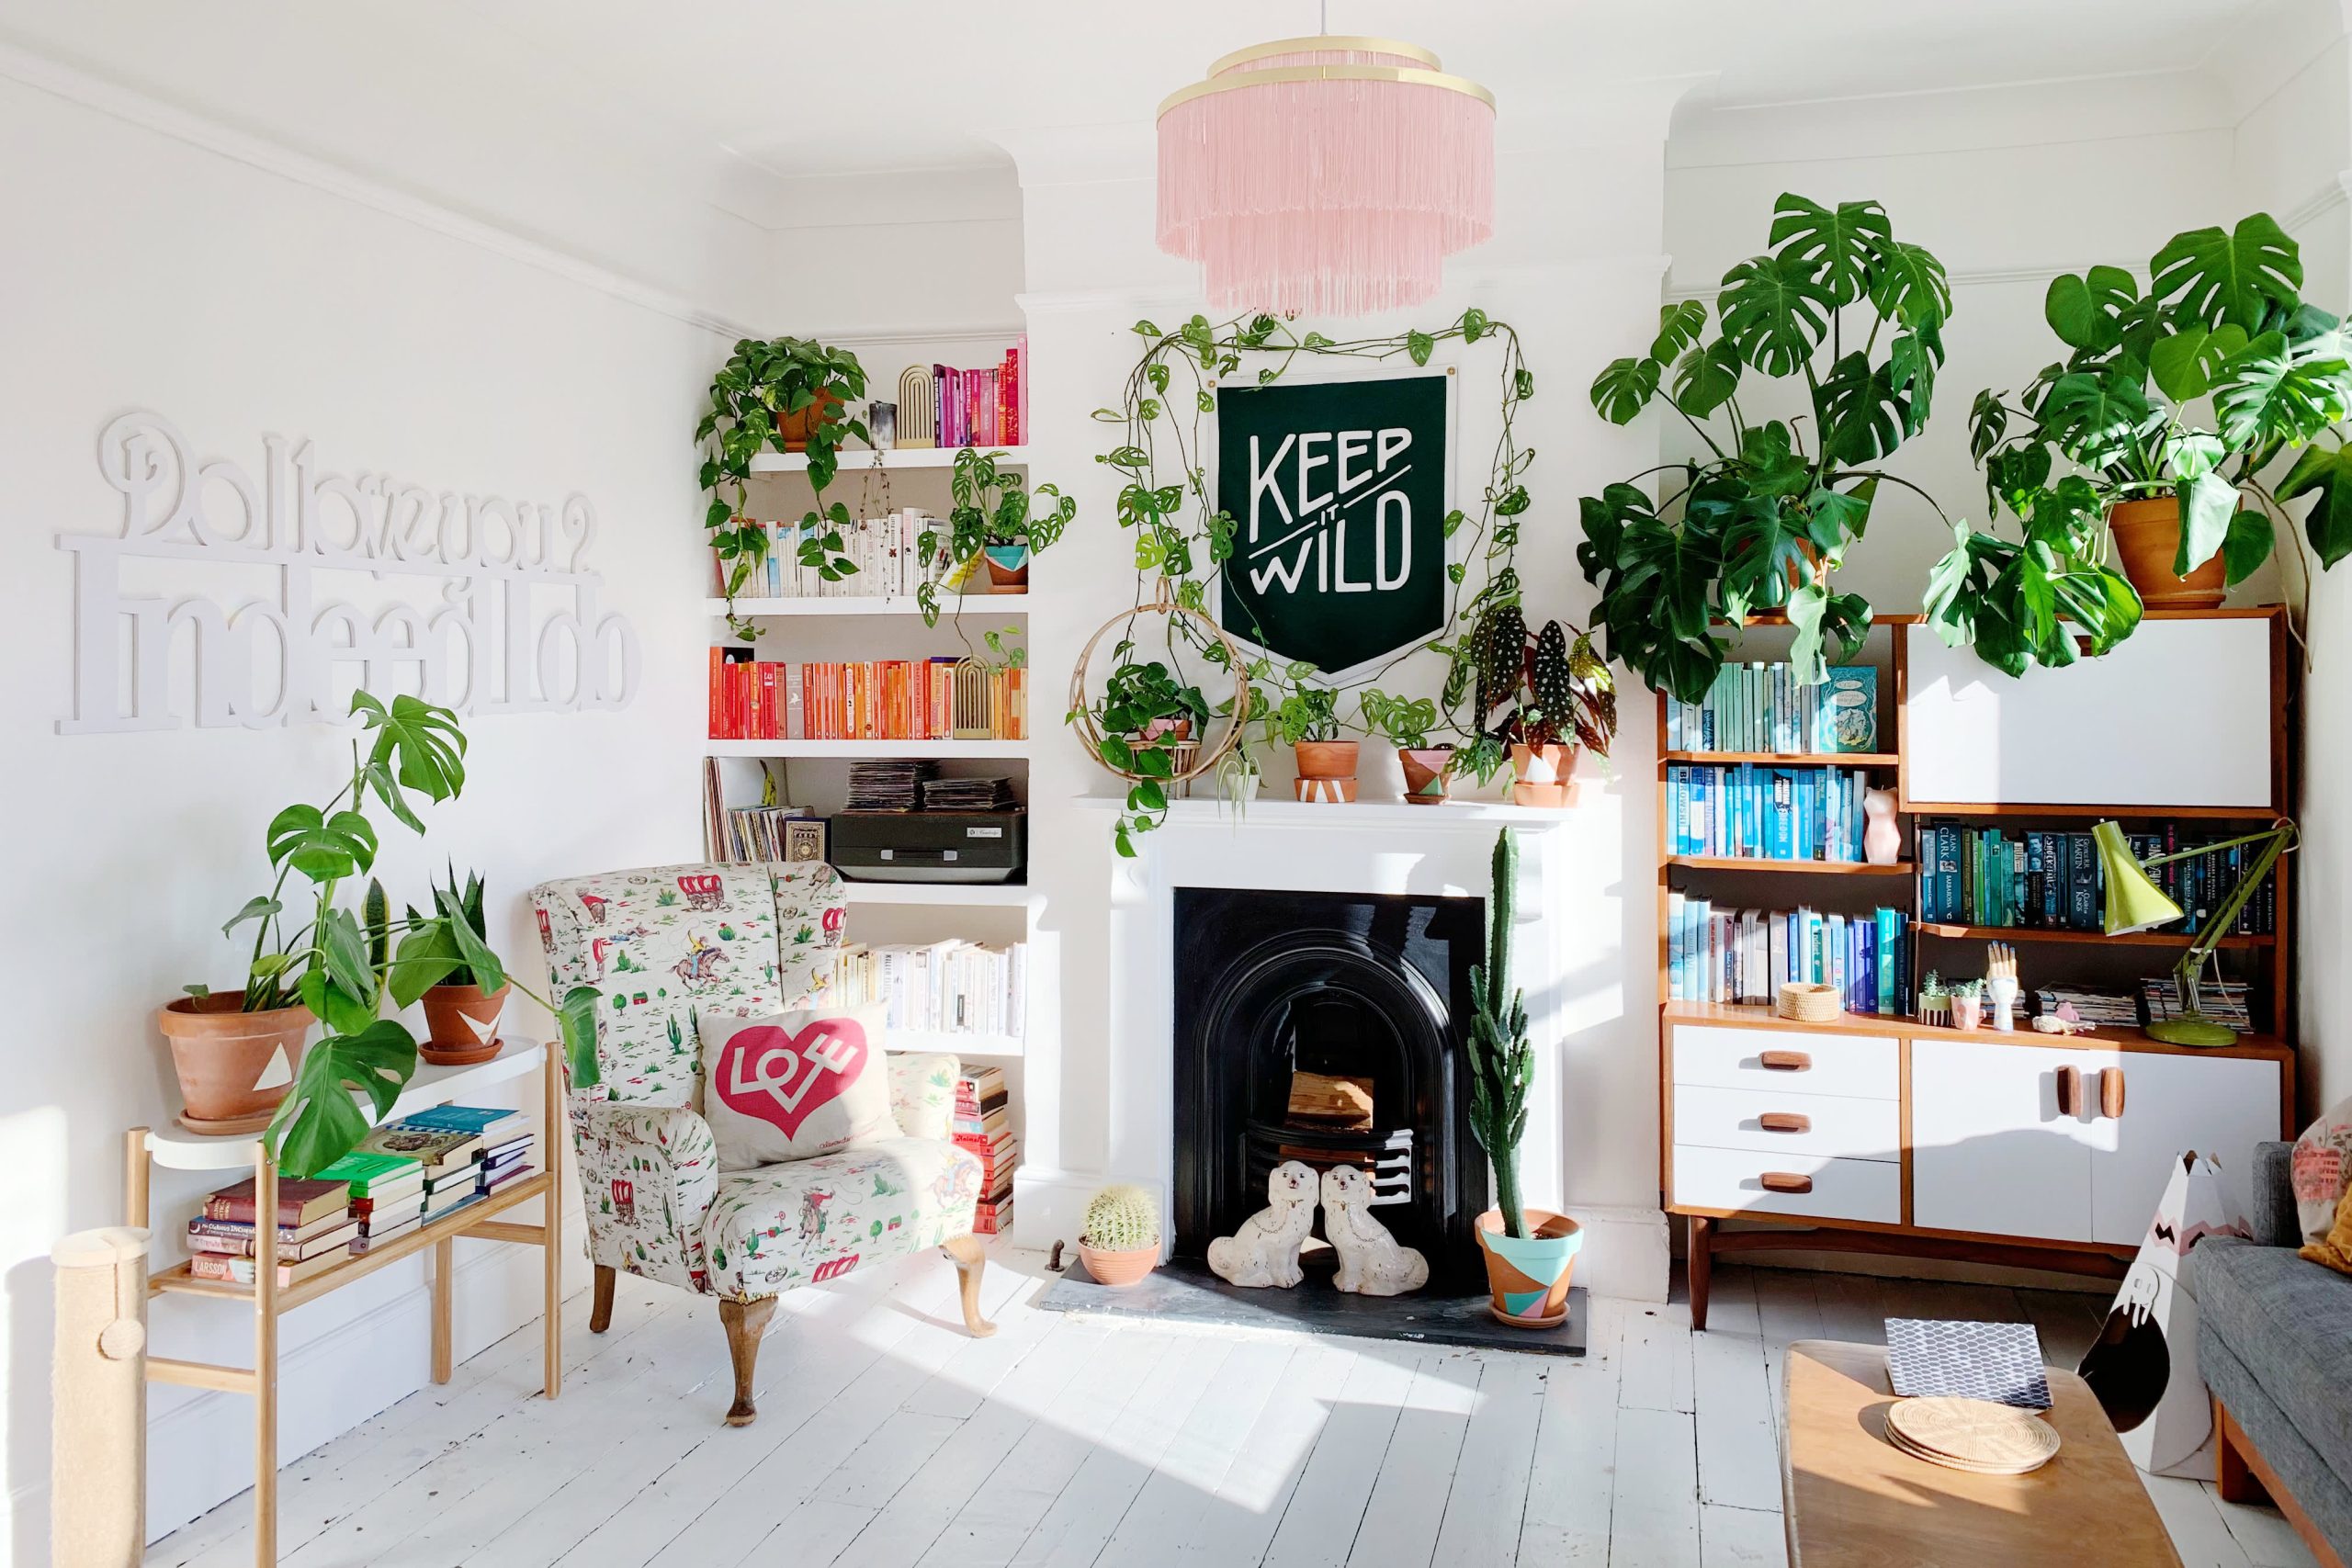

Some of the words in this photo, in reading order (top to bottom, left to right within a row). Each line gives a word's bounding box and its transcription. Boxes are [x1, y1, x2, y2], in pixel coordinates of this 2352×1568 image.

[1249, 427, 1413, 544] KEEP
[1320, 503, 1339, 525] IT
[1249, 490, 1412, 595] WILD
[1939, 827, 1949, 859] CLARK
[2075, 838, 2083, 869] MARTIN
[729, 1032, 859, 1114] LOVE
[195, 1261, 227, 1275] LARSSON
